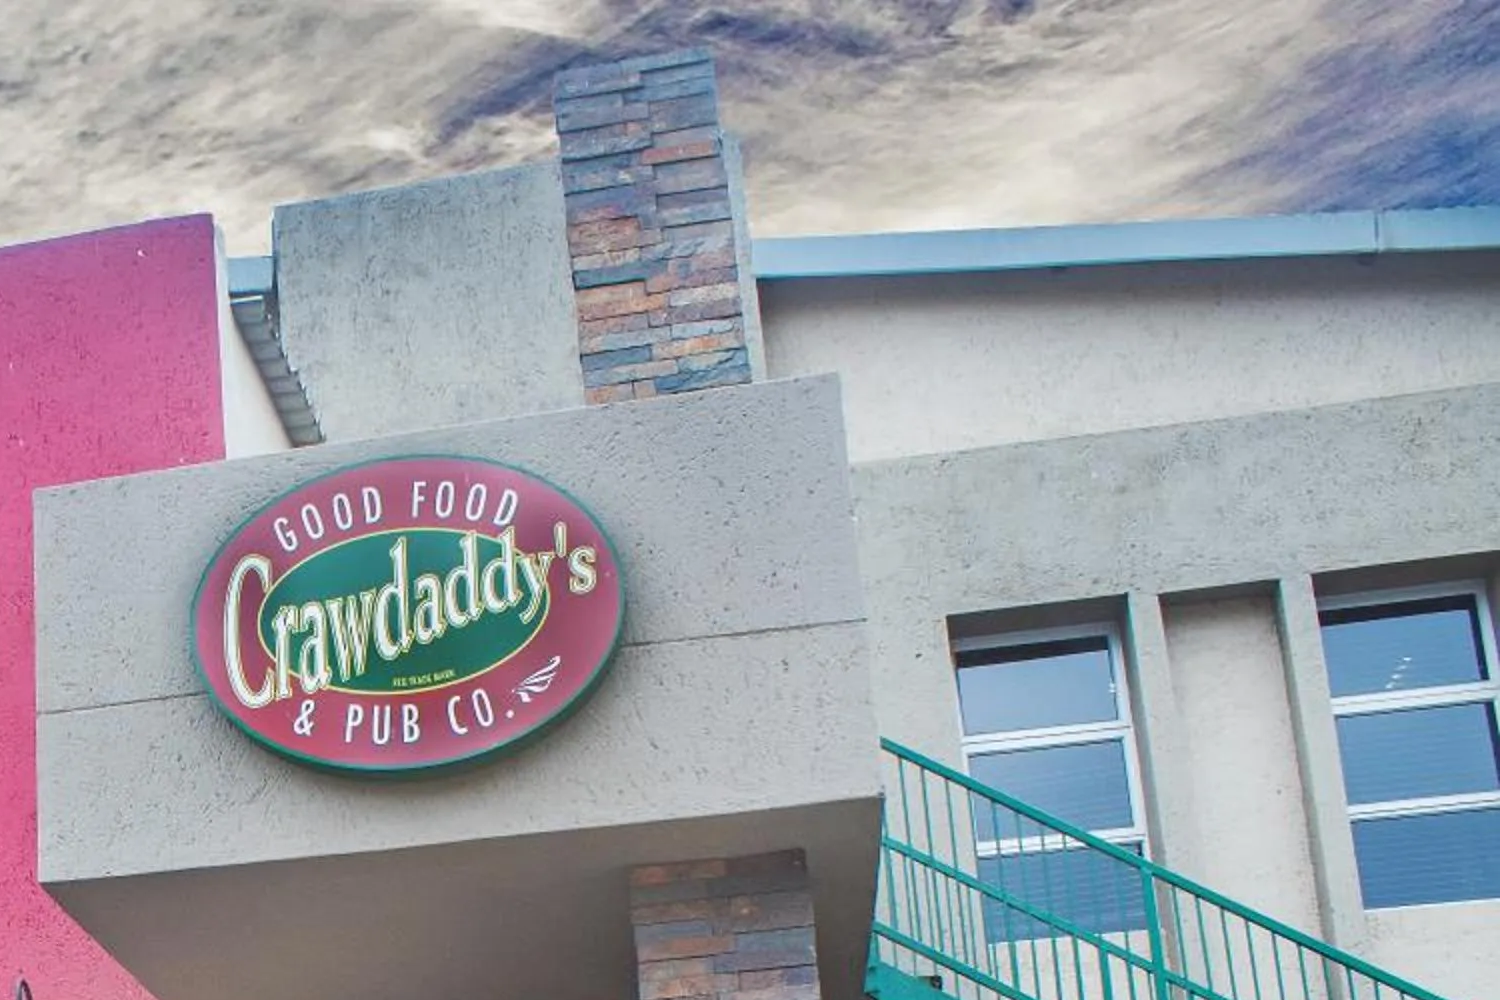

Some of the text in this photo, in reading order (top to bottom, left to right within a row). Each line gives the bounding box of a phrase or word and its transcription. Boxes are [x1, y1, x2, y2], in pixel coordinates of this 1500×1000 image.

[273, 480, 520, 553] GOOD FOOD
[223, 521, 598, 710] Crawdaddy's
[292, 687, 515, 746] & PUB CO.
